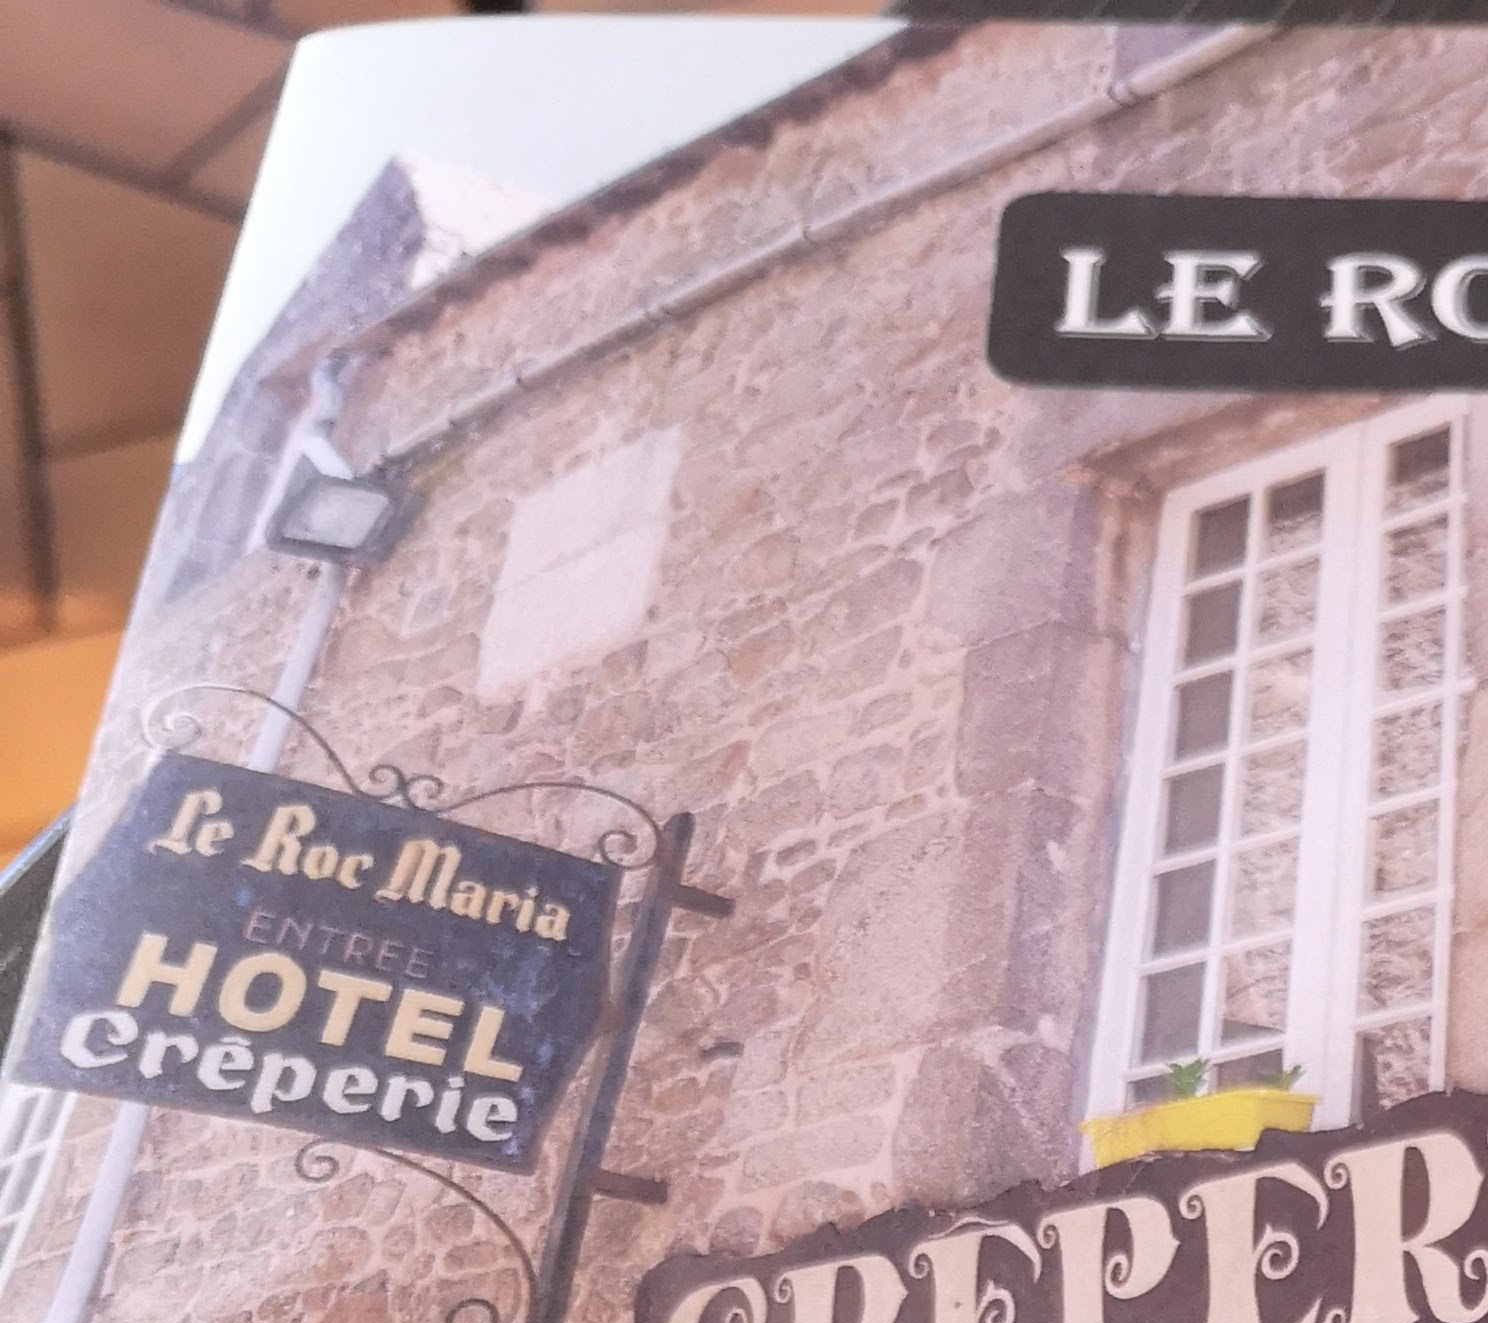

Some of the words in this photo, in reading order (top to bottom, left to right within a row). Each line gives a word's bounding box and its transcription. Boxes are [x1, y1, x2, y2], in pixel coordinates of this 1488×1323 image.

[1055, 246, 1272, 343] LE
[148, 788, 235, 857] Le
[240, 803, 376, 890] Roc
[374, 836, 571, 942] Maria
[59, 1010, 518, 1142] Crêperie
[116, 932, 522, 1082] HOTEL
